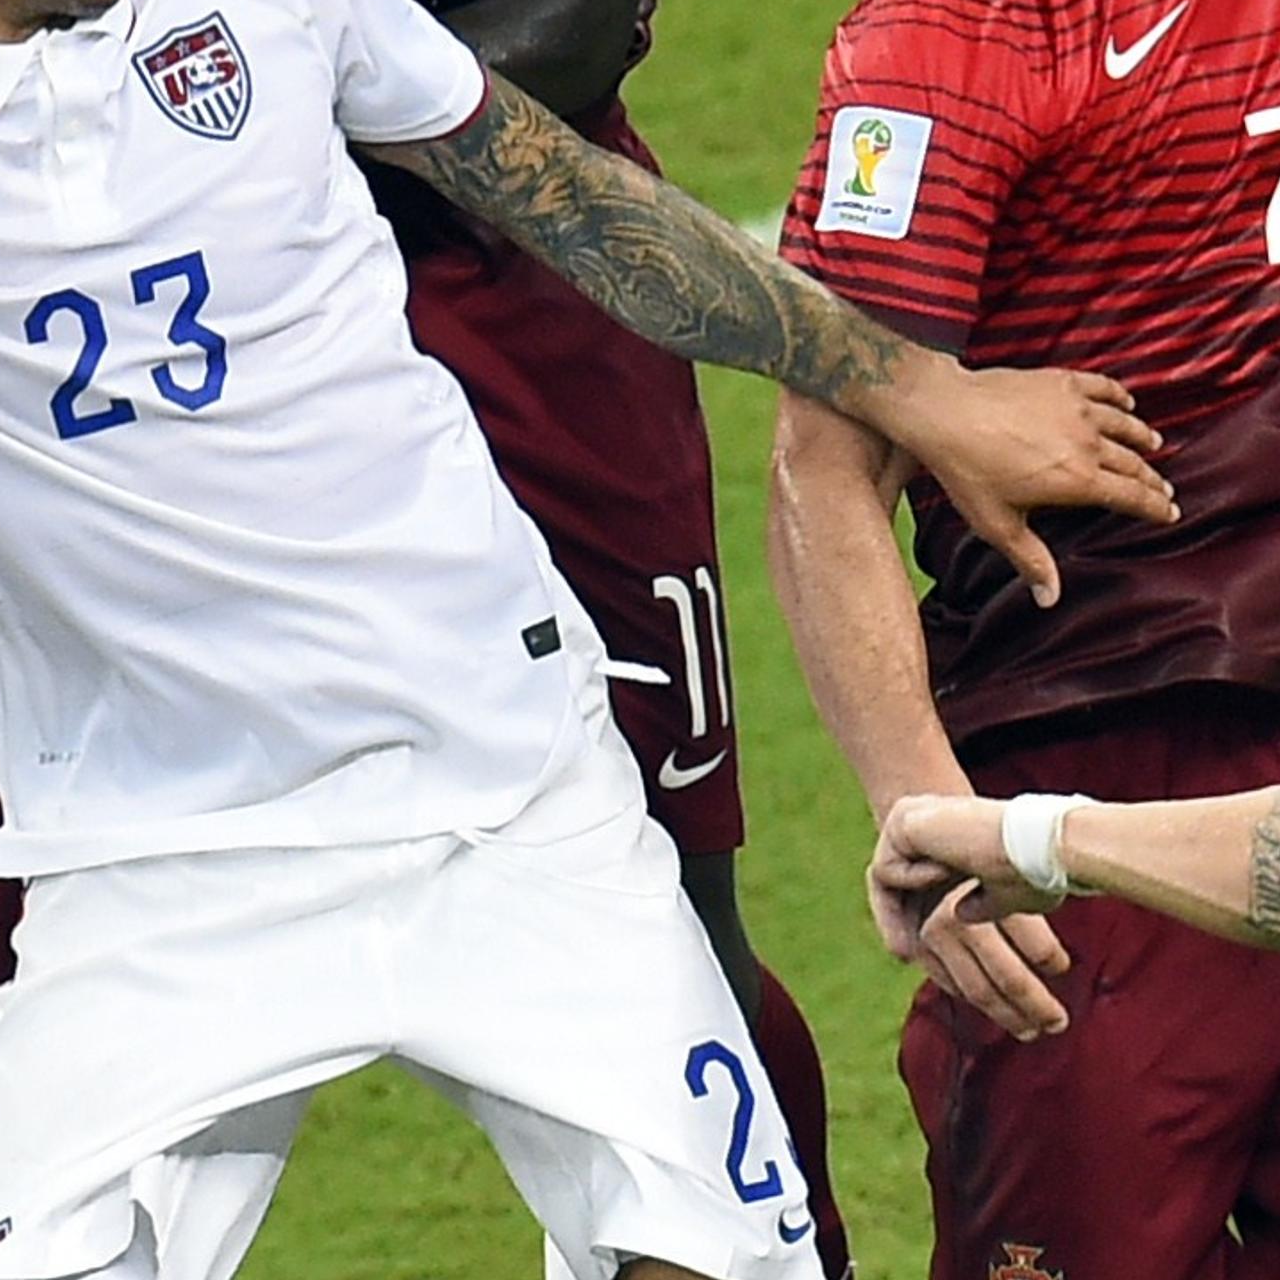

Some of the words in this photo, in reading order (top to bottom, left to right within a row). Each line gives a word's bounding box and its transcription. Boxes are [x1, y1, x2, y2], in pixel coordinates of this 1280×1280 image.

[24, 250, 227, 440] 23
[653, 567, 728, 738] 11
[684, 1039, 800, 1205] 2
